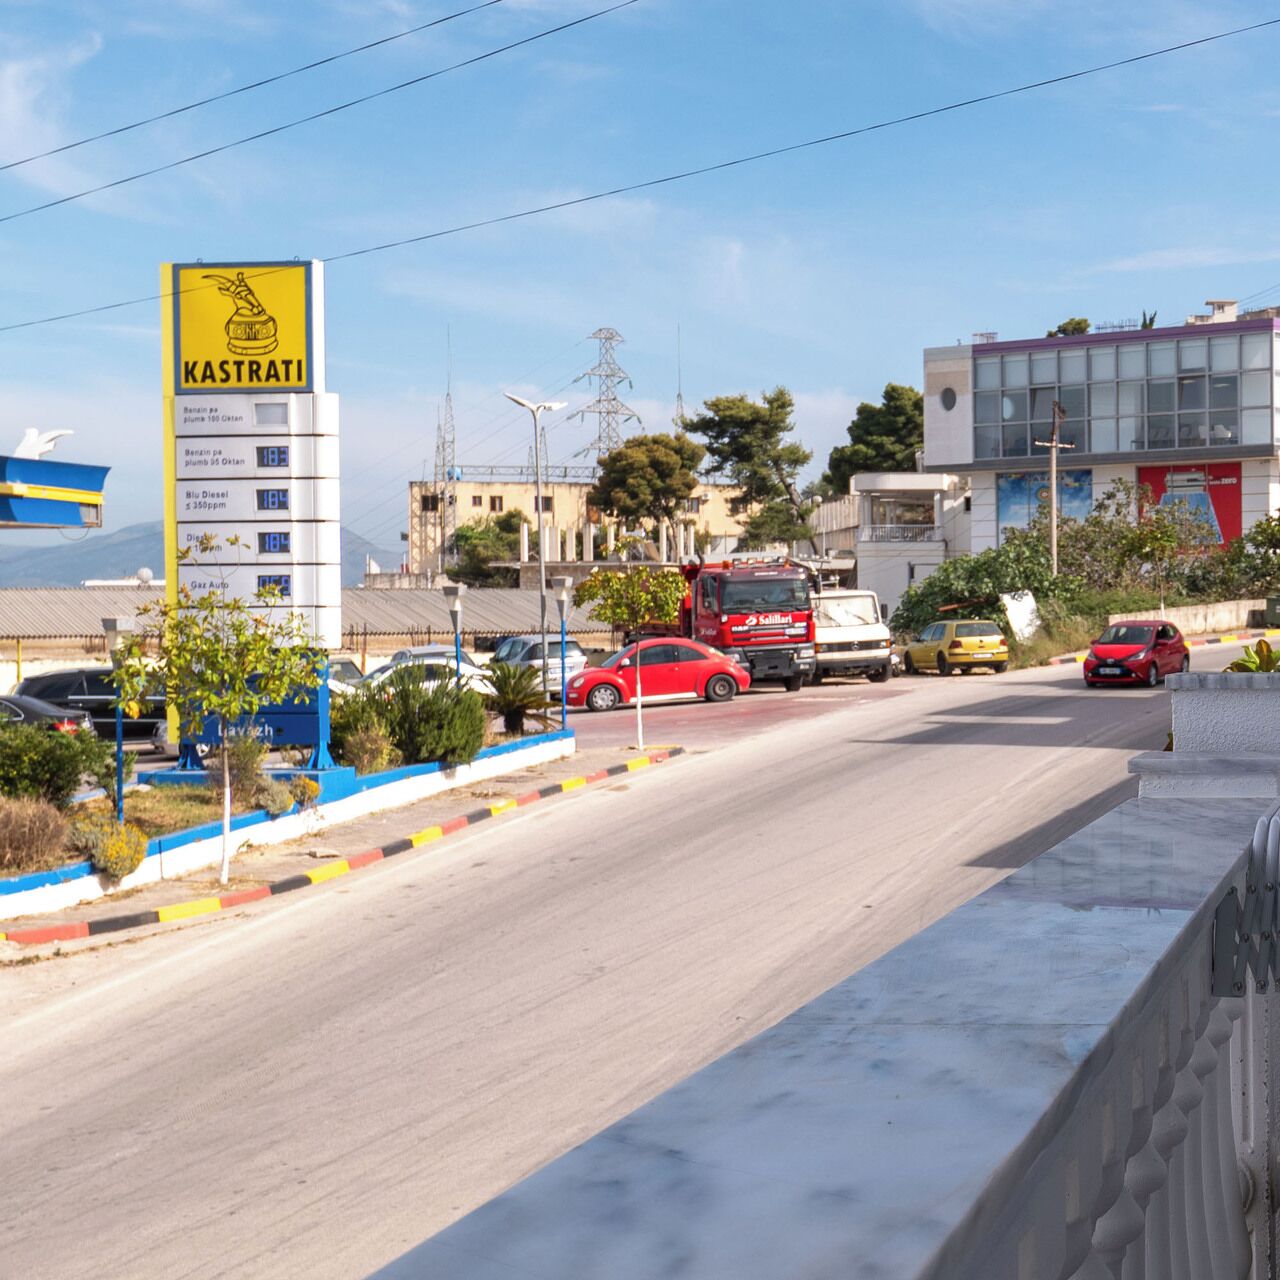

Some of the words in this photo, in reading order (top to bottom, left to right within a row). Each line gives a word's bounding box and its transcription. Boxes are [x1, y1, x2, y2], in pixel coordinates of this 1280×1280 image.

[184, 359, 303, 384] KASTRATI
[185, 448, 211, 456] Benzin
[212, 449, 222, 458] pa
[263, 447, 289, 466] 183
[185, 458, 208, 467] plumb
[221, 457, 245, 466] Oktan
[185, 491, 200, 499] Blu
[202, 490, 229, 499] Diesel
[263, 489, 289, 509] 184
[265, 533, 291, 552] 184
[190, 581, 207, 589] Gaz
[209, 581, 229, 589] Auto
